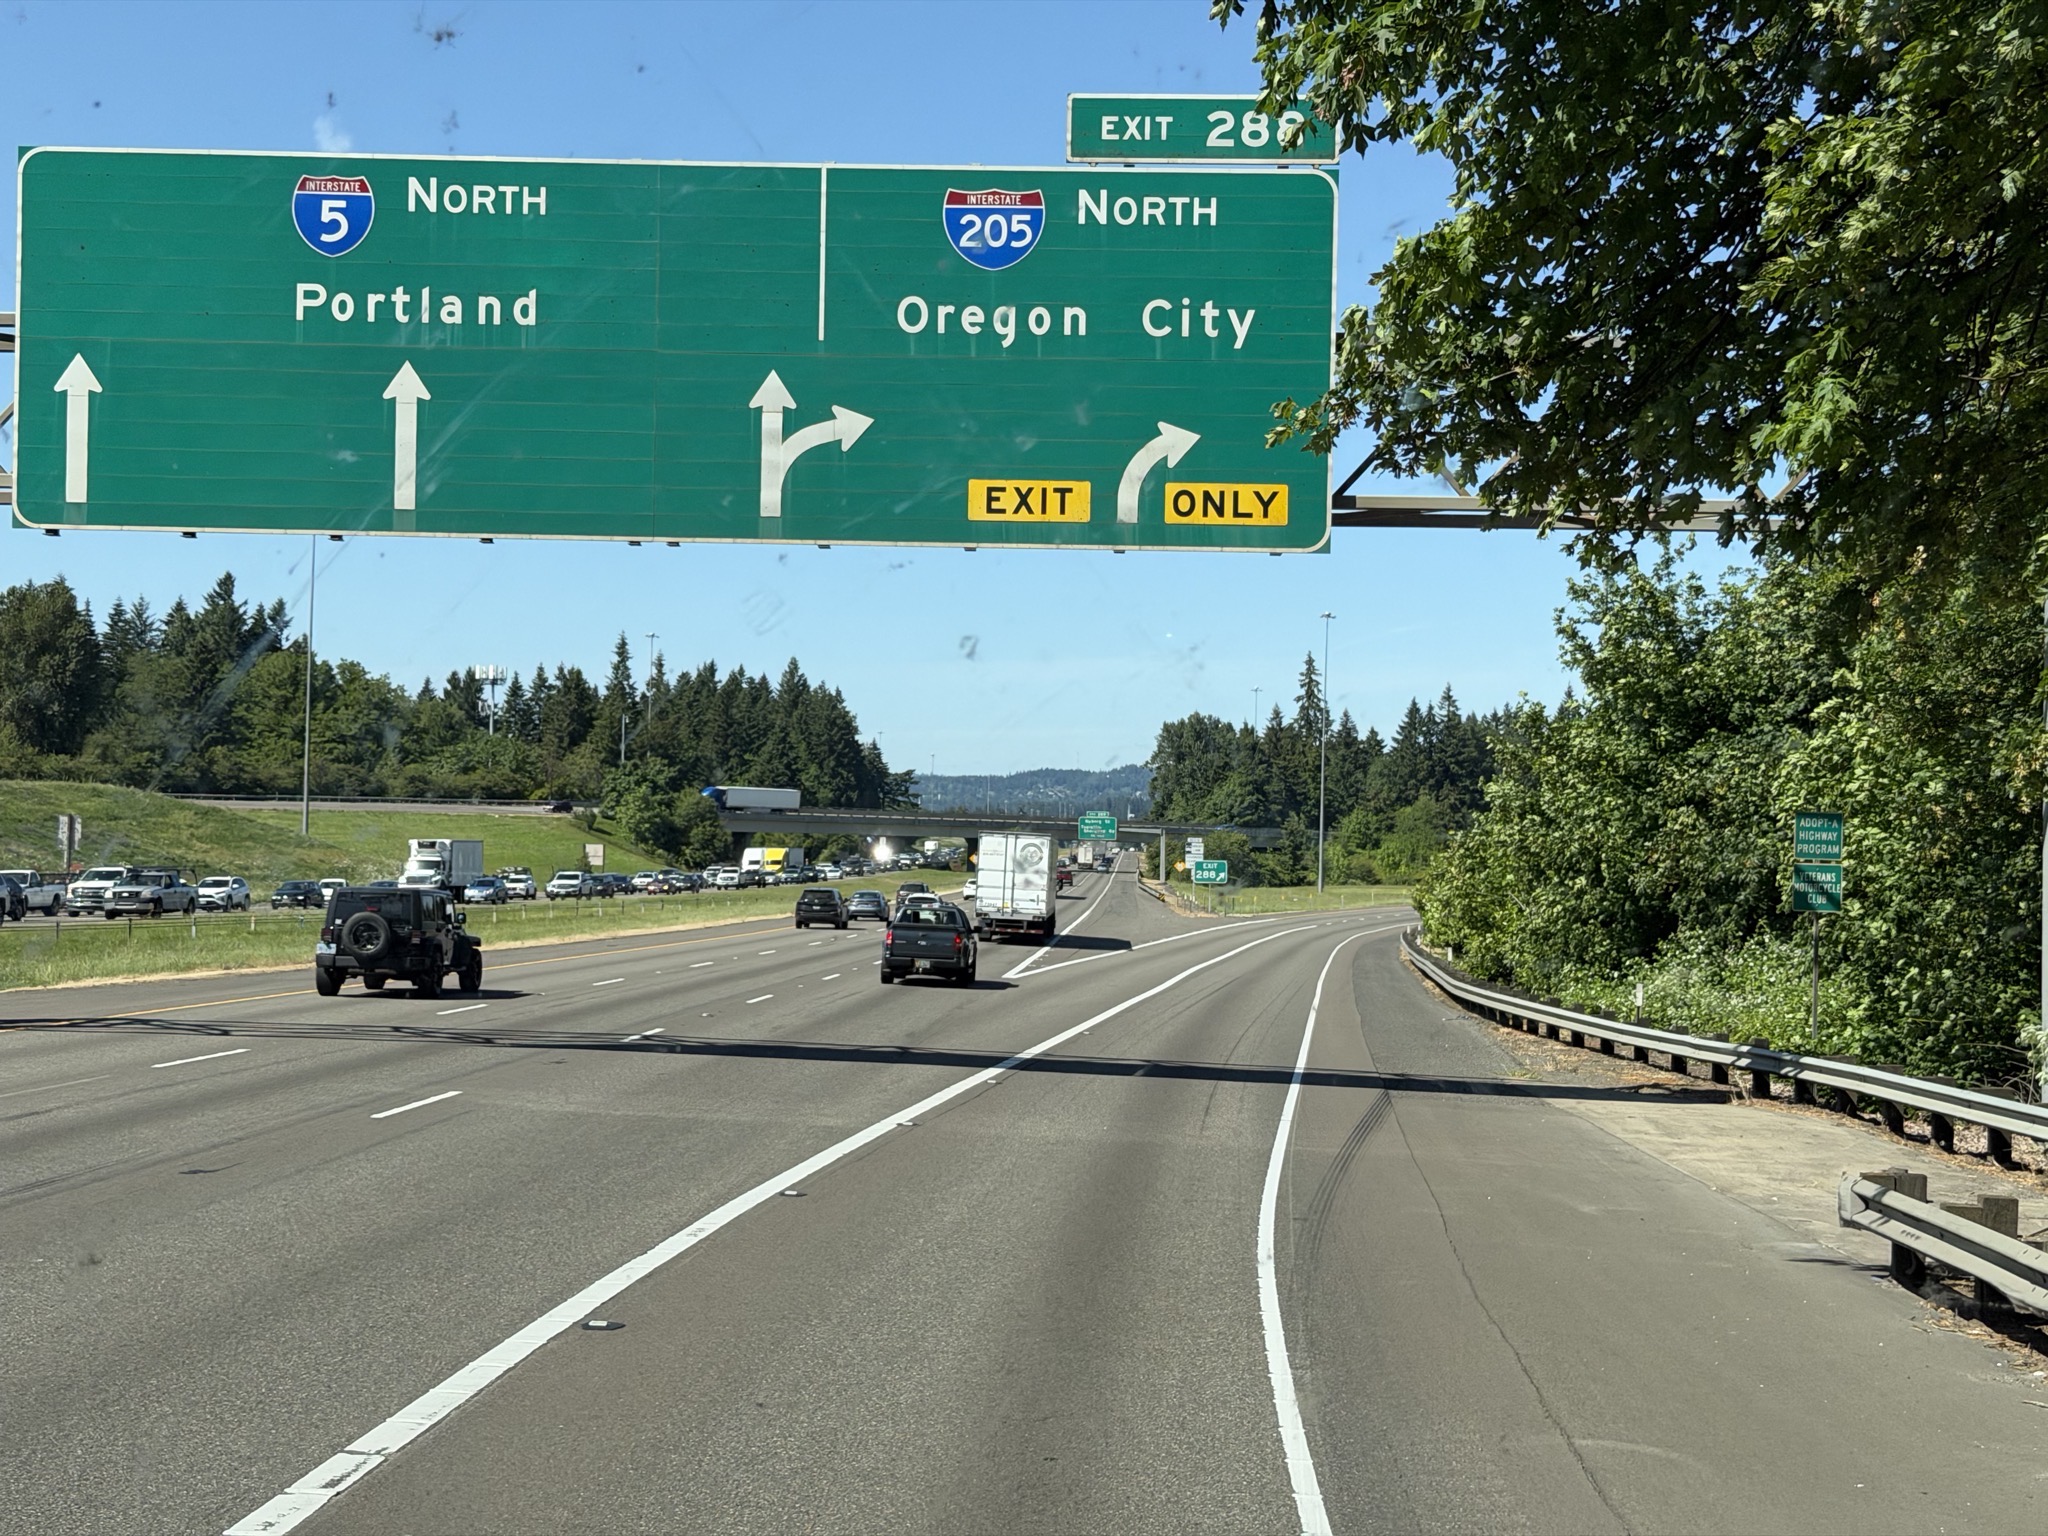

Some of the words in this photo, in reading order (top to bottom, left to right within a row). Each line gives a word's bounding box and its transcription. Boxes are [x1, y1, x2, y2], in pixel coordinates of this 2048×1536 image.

[1101, 115, 1173, 140] EXIT
[305, 180, 361, 192] INTERSTATE
[408, 176, 547, 215] NORTH
[967, 194, 1022, 205] INTERSTATE
[1078, 189, 1217, 226] NORTH
[320, 199, 349, 243] 5
[959, 214, 1032, 248] 205
[296, 283, 537, 326] Portland
[897, 295, 1087, 348] Oregon
[1142, 297, 1255, 349] City
[985, 486, 1074, 515] EXIT
[1172, 489, 1280, 519] ONLY
[1799, 817, 1839, 829] ADOPT-A
[1799, 830, 1838, 841] HIGHWAY
[1797, 843, 1839, 854] PROGRAM
[1196, 870, 1216, 879] 288
[1799, 871, 1836, 882] VETERANS
[1793, 883, 1841, 893] MOTORCYCLE
[1807, 893, 1827, 904] CLUB
